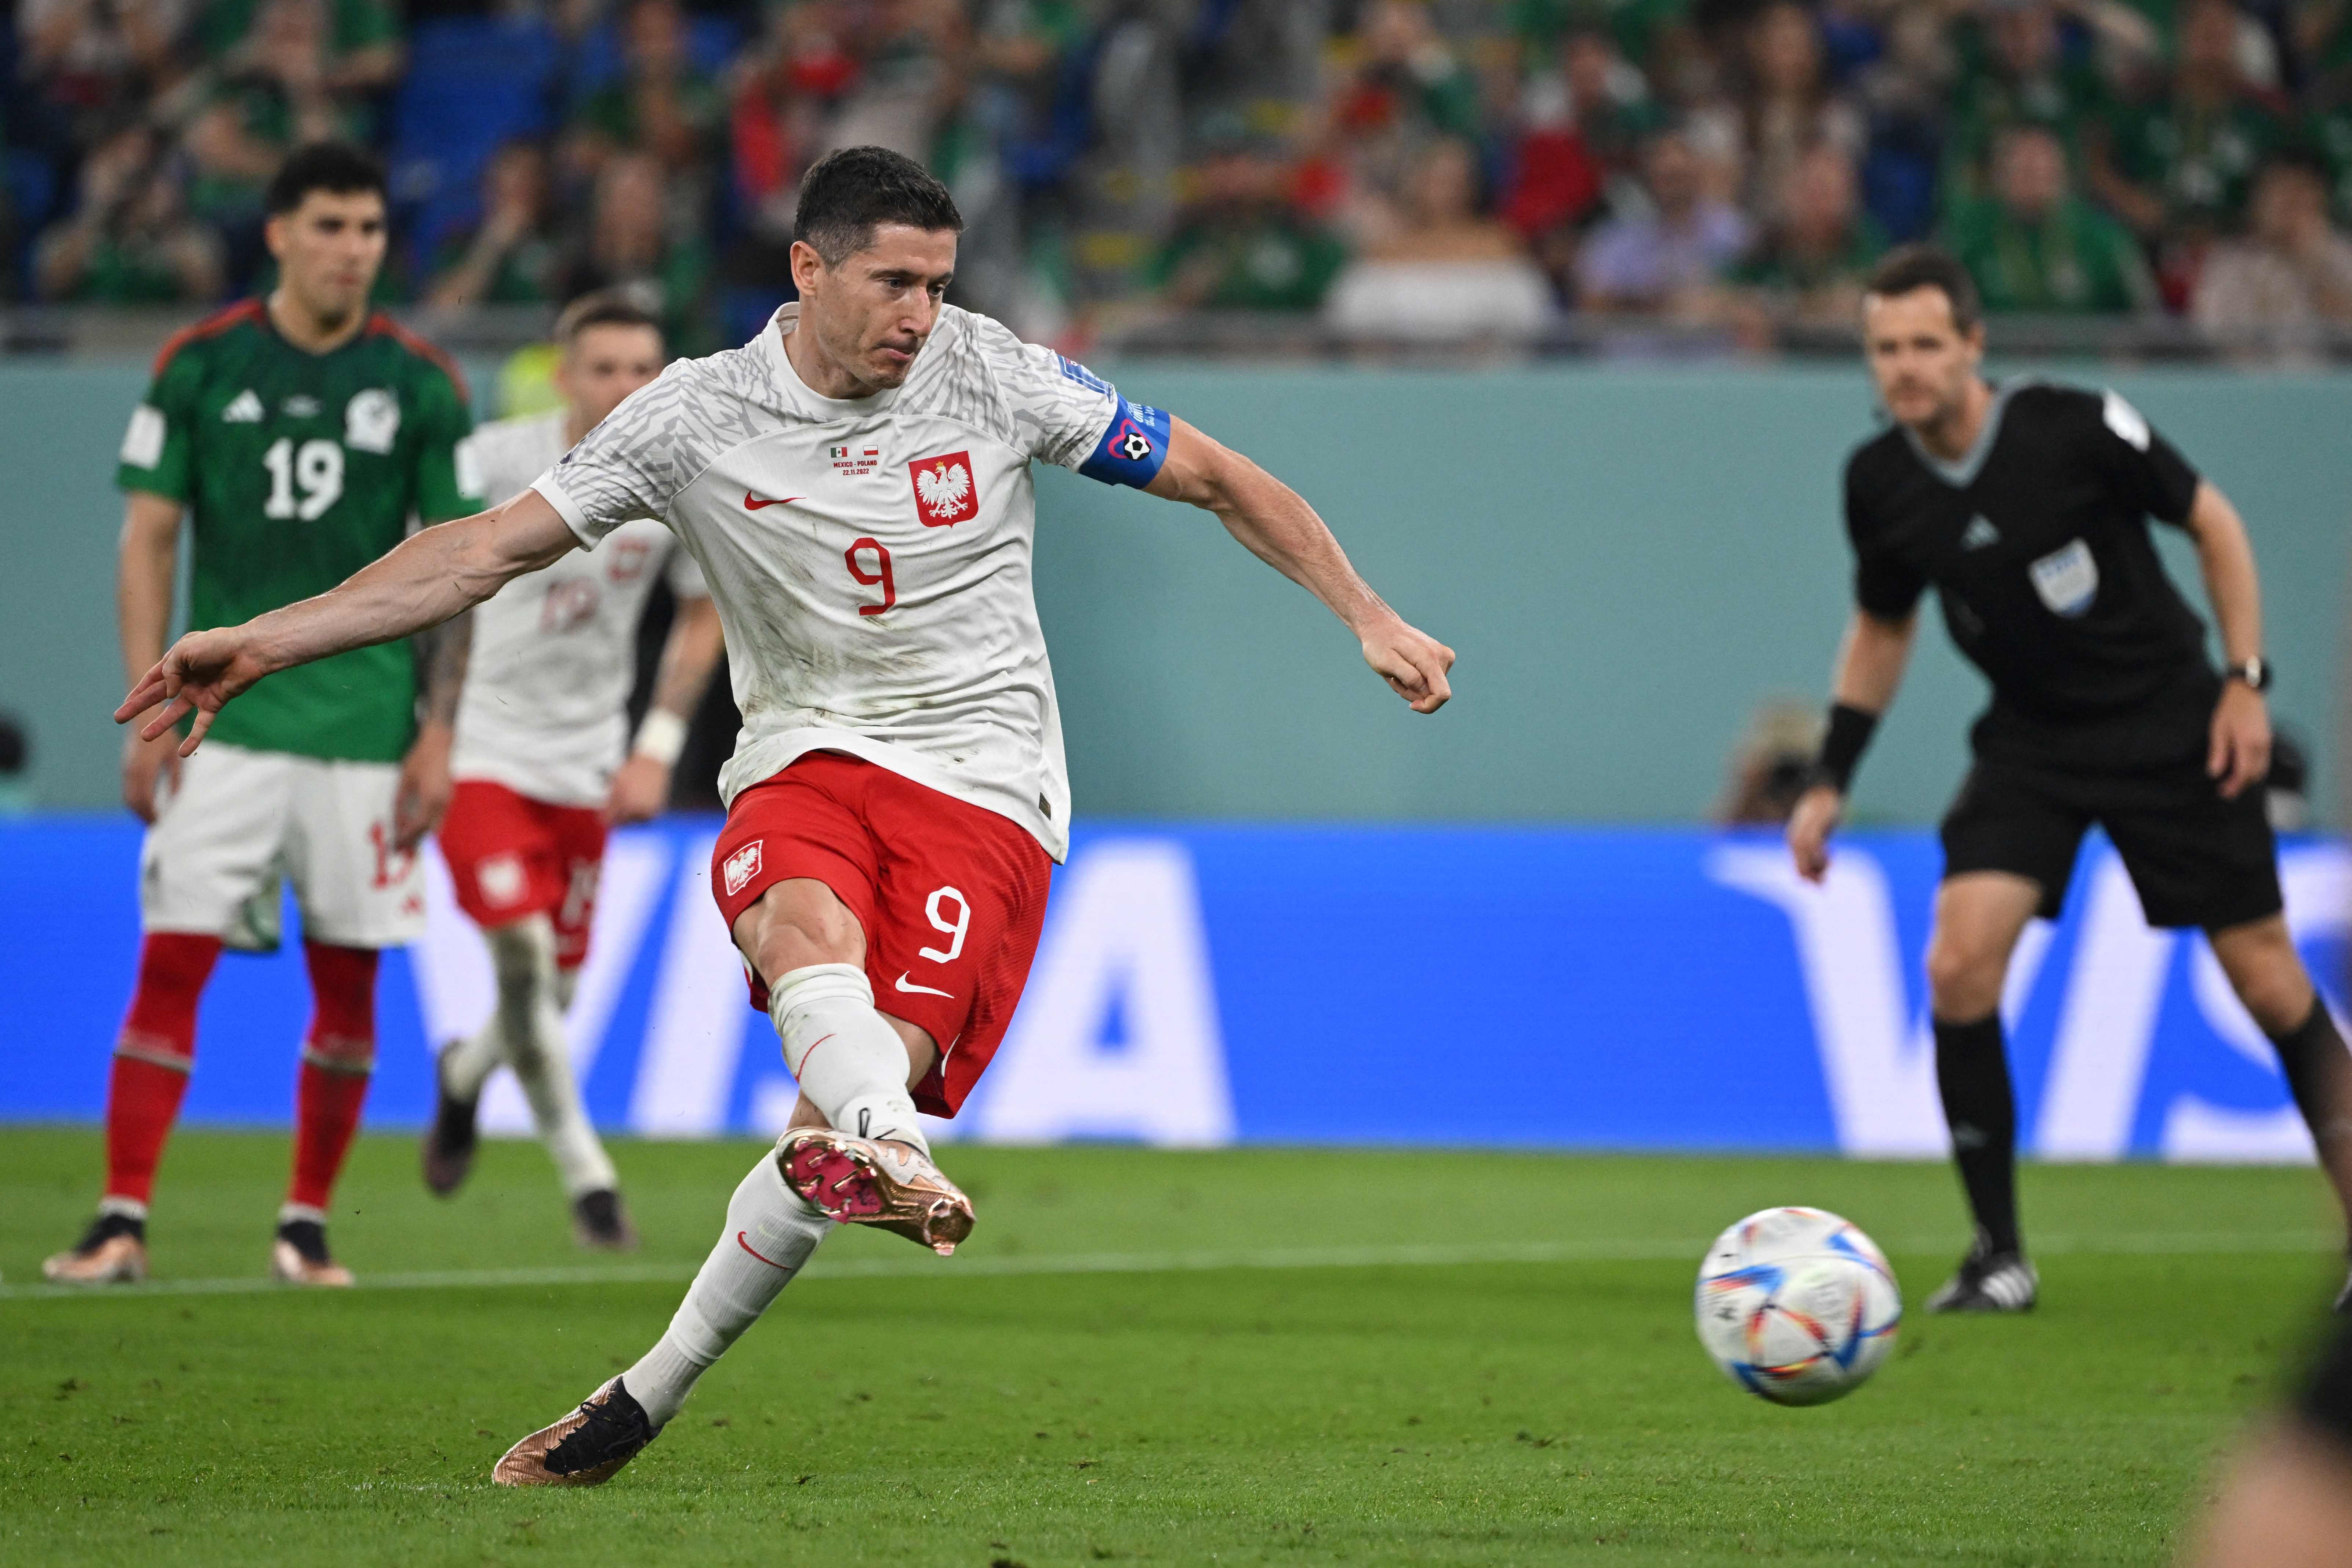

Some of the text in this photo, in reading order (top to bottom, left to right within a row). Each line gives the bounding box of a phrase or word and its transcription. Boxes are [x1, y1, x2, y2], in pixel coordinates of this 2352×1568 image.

[262, 438, 346, 521] 19
[844, 537, 896, 616] 9
[918, 886, 971, 964] 9
[406, 830, 1239, 1147] VIA
